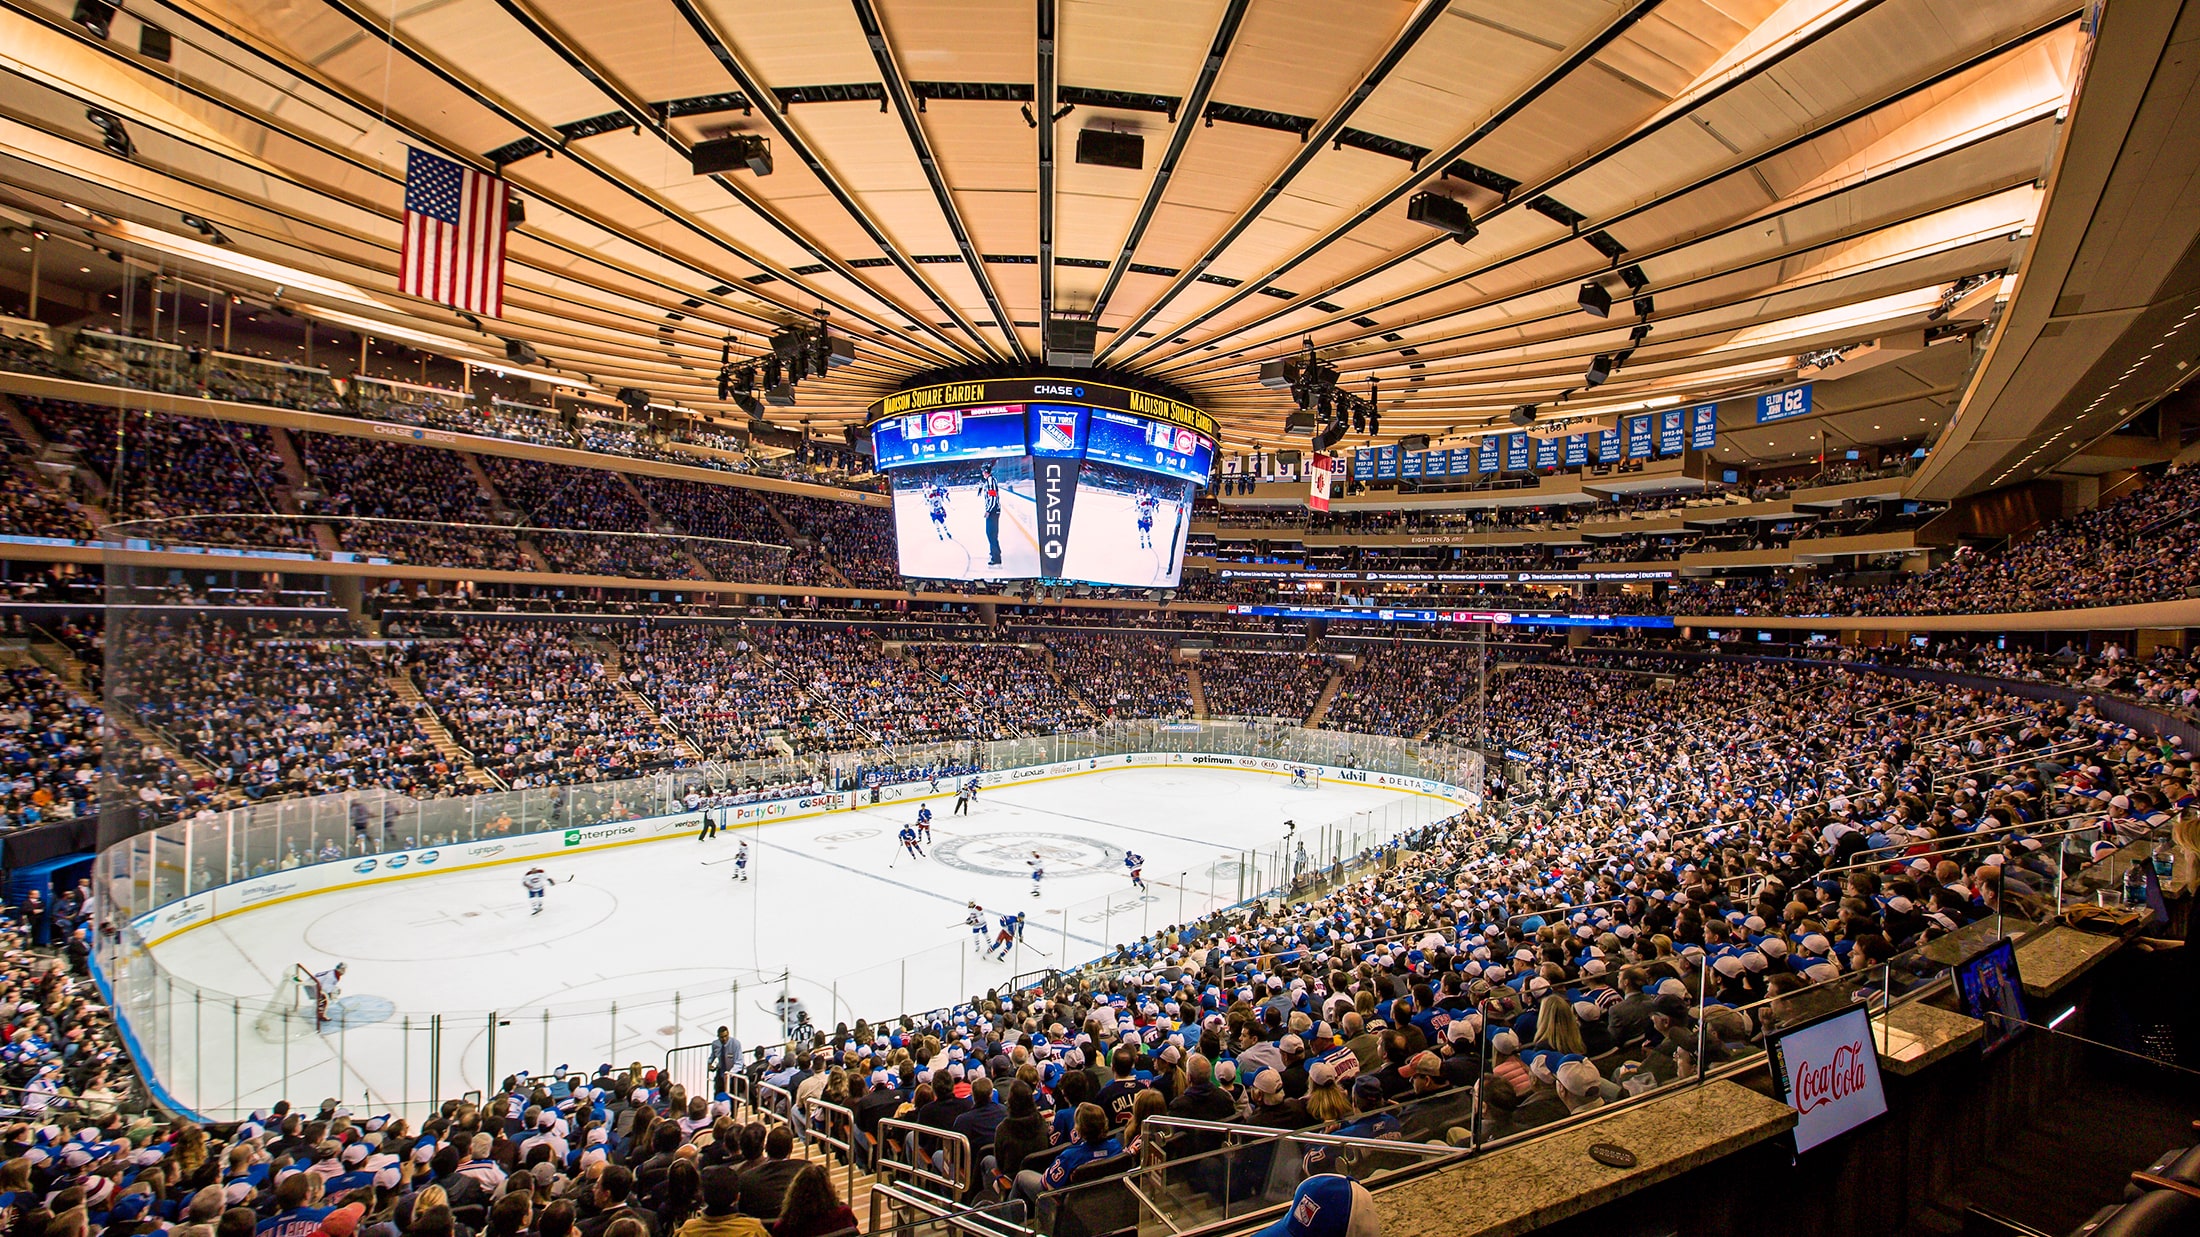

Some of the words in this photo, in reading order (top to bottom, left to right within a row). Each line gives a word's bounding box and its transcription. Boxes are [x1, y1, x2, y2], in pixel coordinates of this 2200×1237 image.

[1034, 386, 1072, 396] CHASE
[884, 393, 910, 415] MADISON
[912, 388, 943, 409] SQUARE
[945, 384, 984, 404] GARDEN
[1766, 393, 1783, 406] ELTON
[1785, 389, 1802, 411] 62
[1130, 392, 1169, 418] MADISON
[1170, 400, 1194, 426] SQUARE
[1196, 410, 1212, 434] GARDEN
[374, 426, 412, 436] CHASE
[425, 432, 456, 443] BRIDGE
[912, 443, 919, 455] 0
[940, 440, 948, 452] 0
[1156, 452, 1163, 464] 0
[1180, 458, 1186, 470] 0
[1228, 463, 1236, 474] 7
[1046, 464, 1060, 536] CHASE
[1020, 769, 1045, 779] LEXUS
[1338, 770, 1366, 782] Advil
[1390, 777, 1421, 788] DELTA
[1423, 782, 1437, 791] SAP
[737, 807, 765, 819] Party
[767, 804, 787, 816] City
[674, 820, 700, 828] verizon
[570, 826, 636, 842] enterprise
[1078, 900, 1144, 924] CHASE
[1796, 1041, 1866, 1114] Coca-Cola
[1112, 1094, 1134, 1113] CALL
